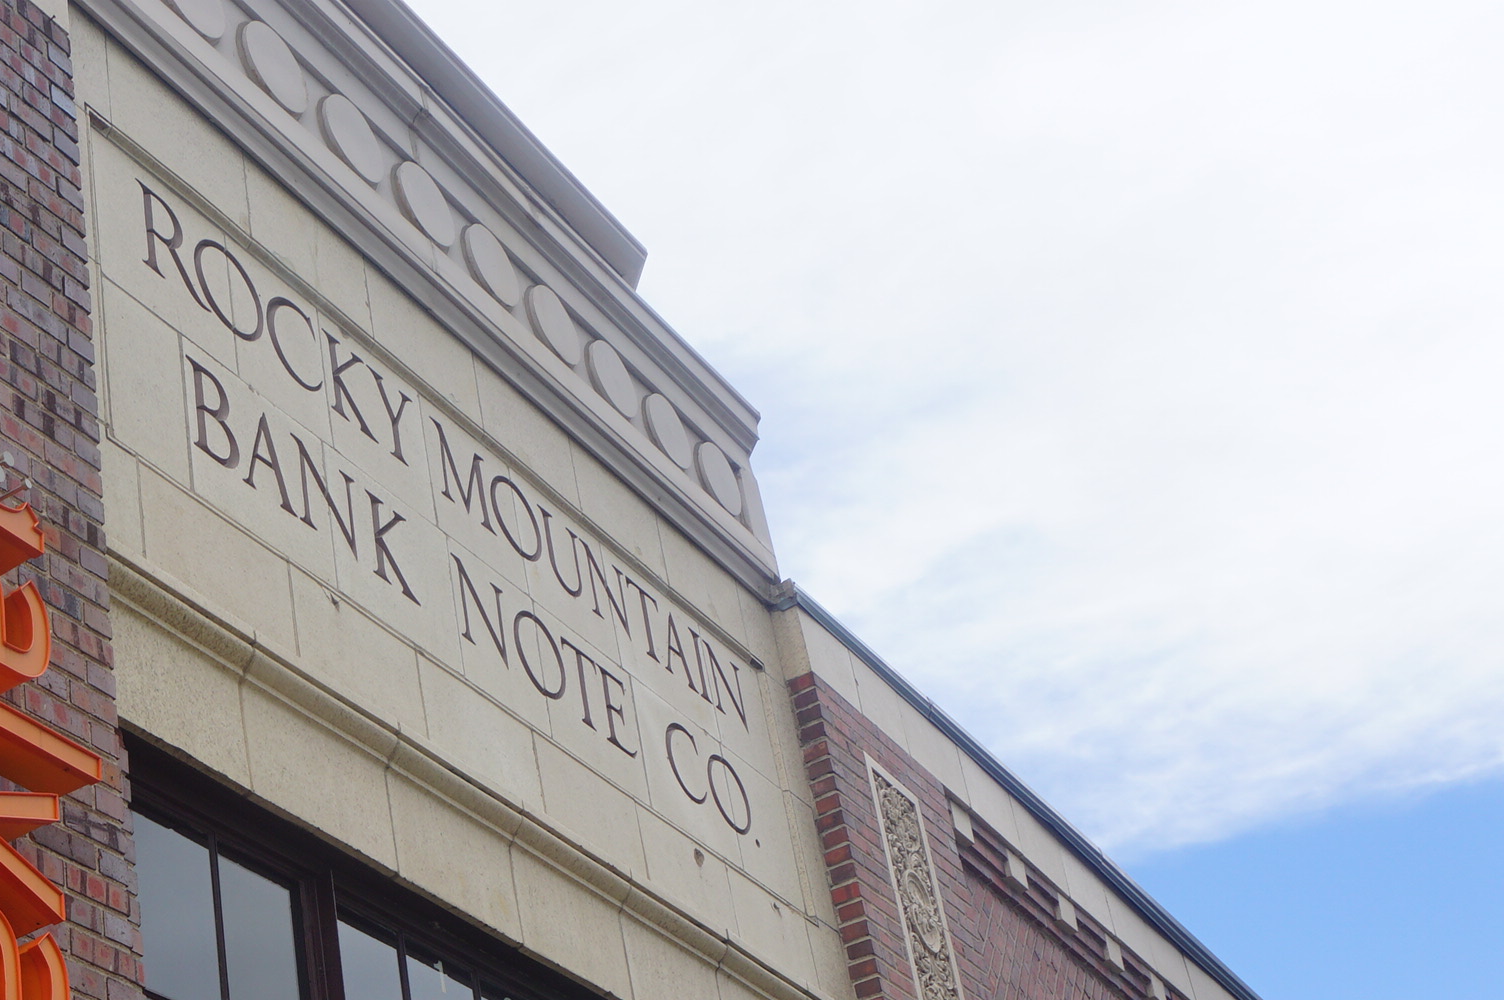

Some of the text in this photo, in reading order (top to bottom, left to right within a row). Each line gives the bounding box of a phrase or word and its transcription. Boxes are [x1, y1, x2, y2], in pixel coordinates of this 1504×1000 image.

[136, 177, 749, 734] ROCKY MOUNTAIN
[185, 354, 762, 848] BANK NOTE CO.
